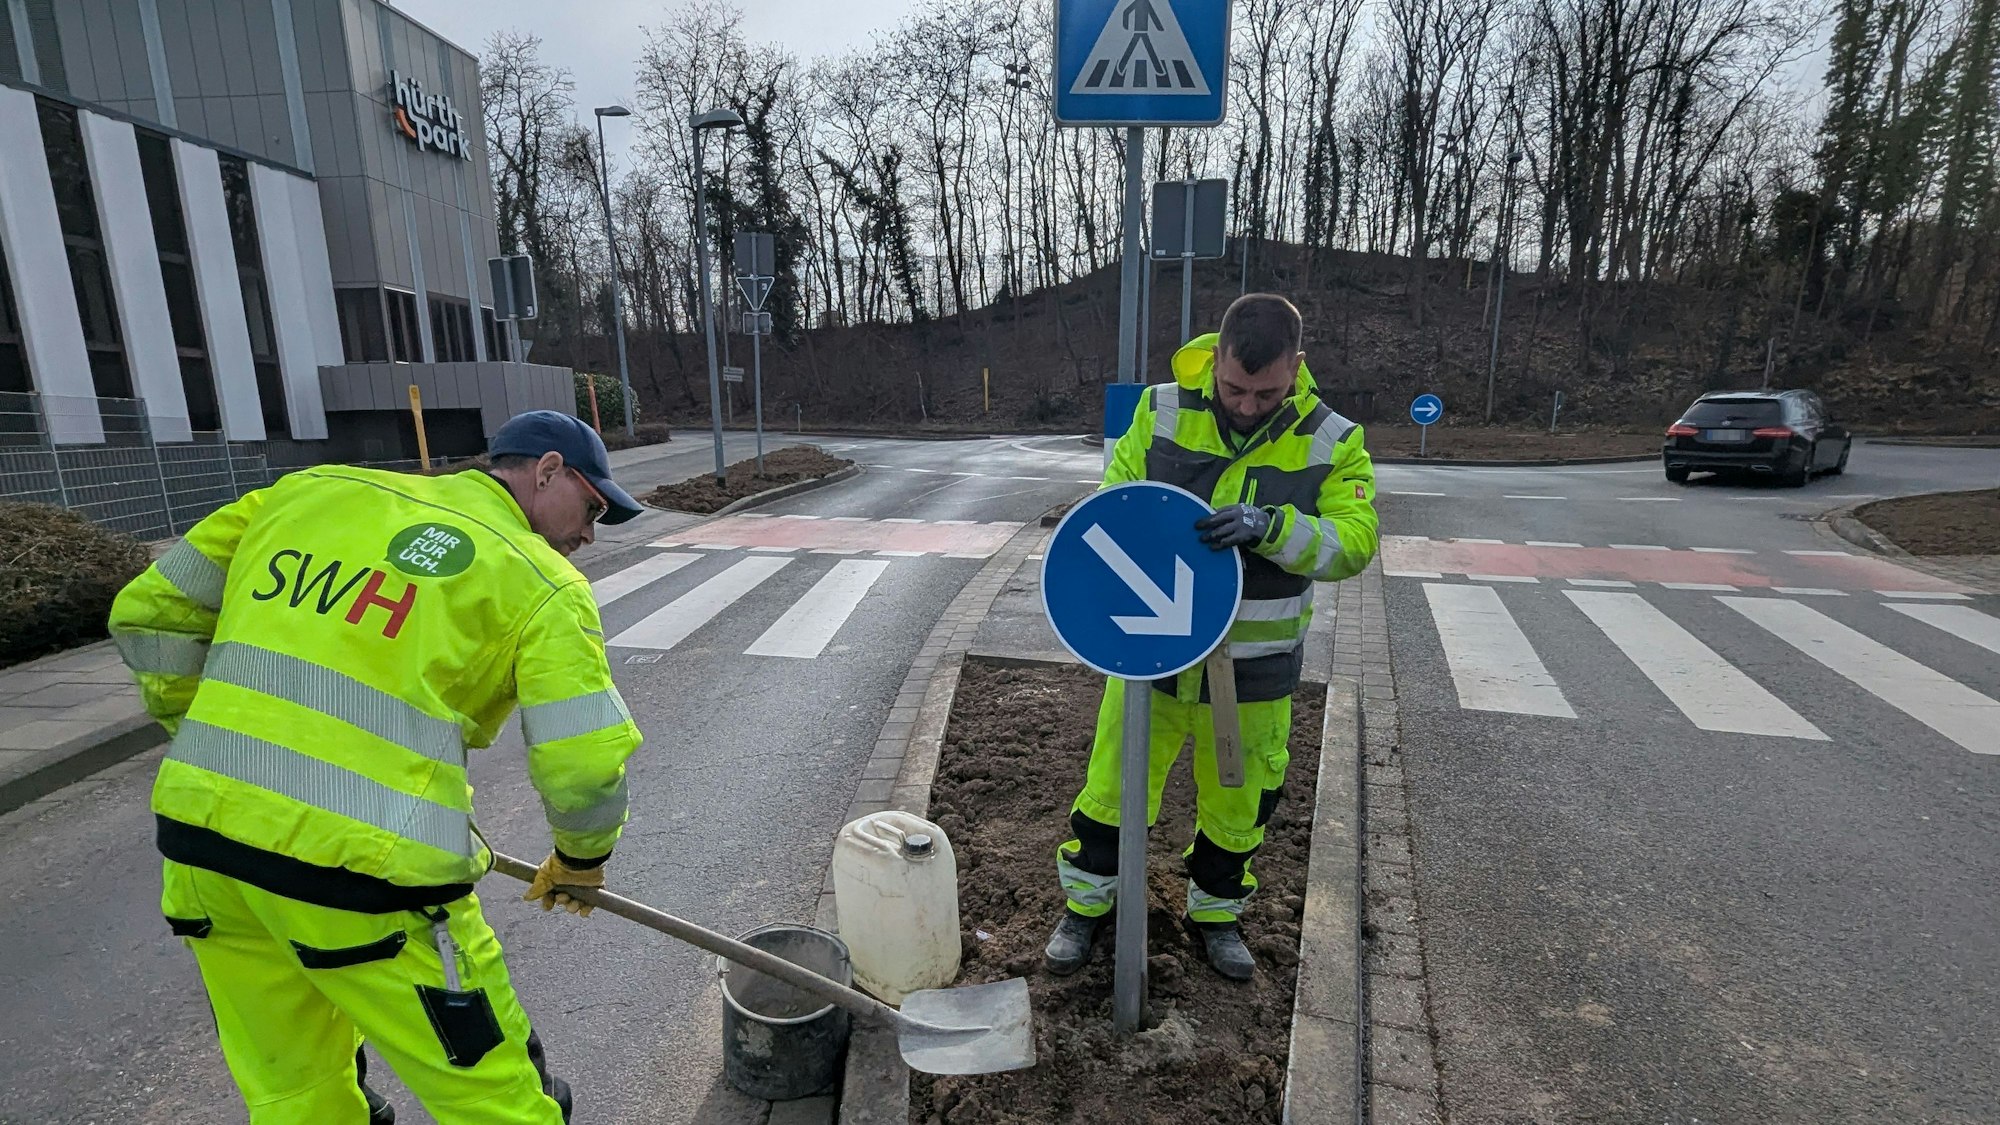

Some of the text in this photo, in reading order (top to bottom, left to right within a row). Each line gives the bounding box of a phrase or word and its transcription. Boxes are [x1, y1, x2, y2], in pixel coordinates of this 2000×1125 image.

[391, 70, 461, 129] hürth
[415, 118, 472, 162] park
[409, 537, 448, 559] FÜR
[422, 526, 461, 549] MIR
[399, 547, 439, 573] ÜCH.
[251, 549, 418, 640] SWH
